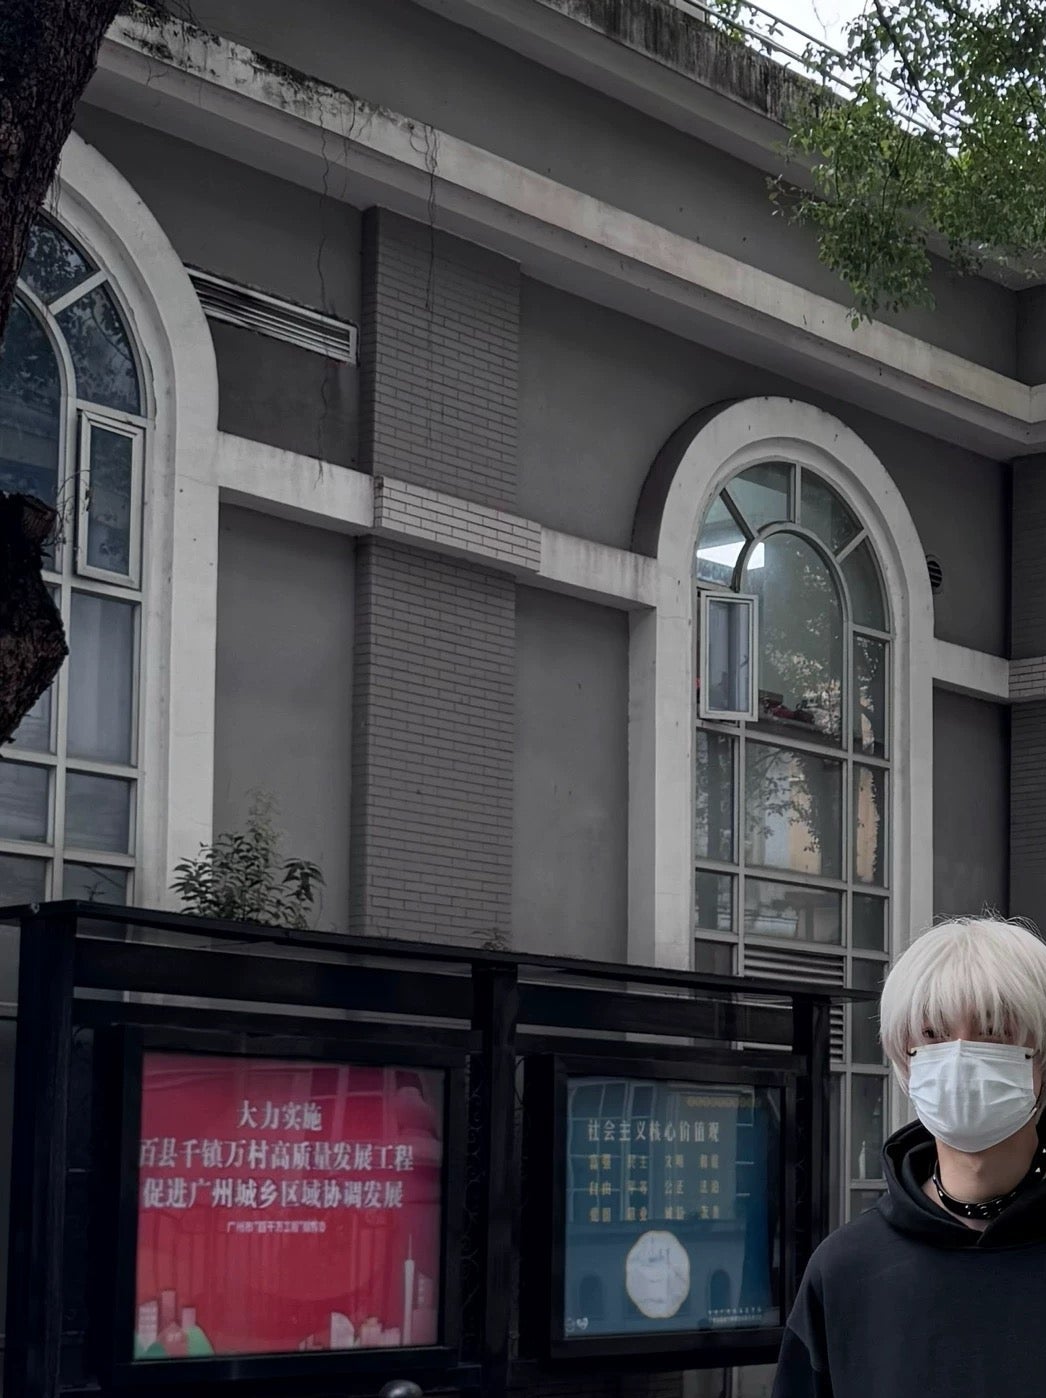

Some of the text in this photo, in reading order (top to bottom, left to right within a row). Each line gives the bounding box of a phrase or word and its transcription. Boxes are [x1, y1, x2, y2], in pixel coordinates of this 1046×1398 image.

[238, 1100, 323, 1131] 大力实施
[588, 1119, 720, 1143] 社会主义核心价值观
[139, 1137, 414, 1172] 百县千镇万村高质量发展工程
[143, 1178, 403, 1209] 促进广州城乡区域协调发展
